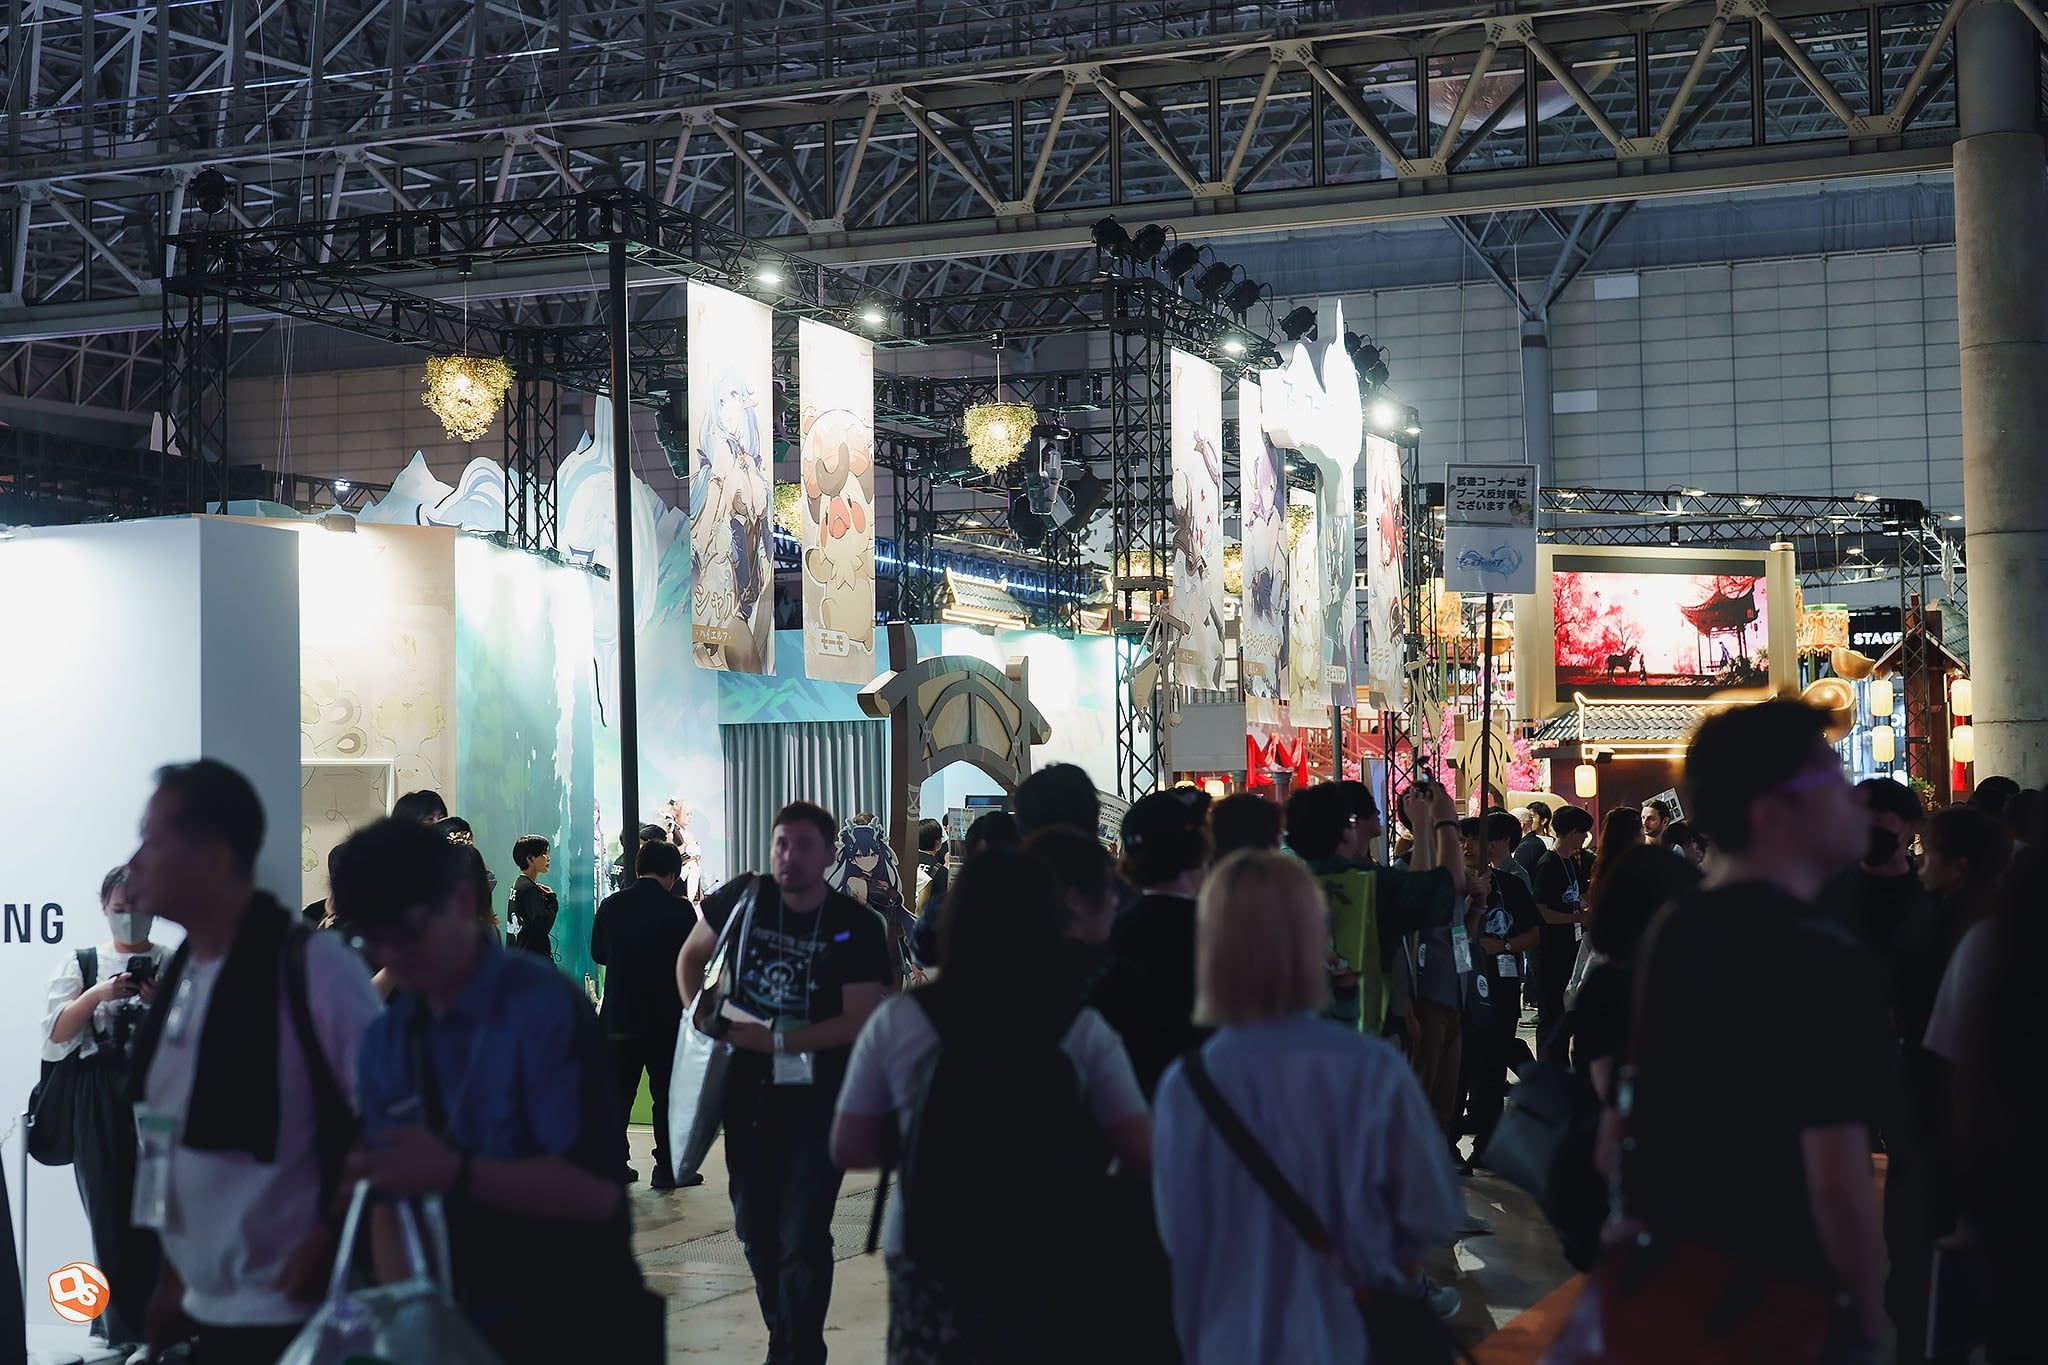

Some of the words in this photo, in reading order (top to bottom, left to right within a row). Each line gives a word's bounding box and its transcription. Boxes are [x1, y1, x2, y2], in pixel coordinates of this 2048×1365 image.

[1456, 476, 1527, 487] 試遊コーナーは
[1456, 488, 1527, 499] ブース反対側に
[1456, 500, 1506, 511] ございます
[4, 902, 64, 945] NG
